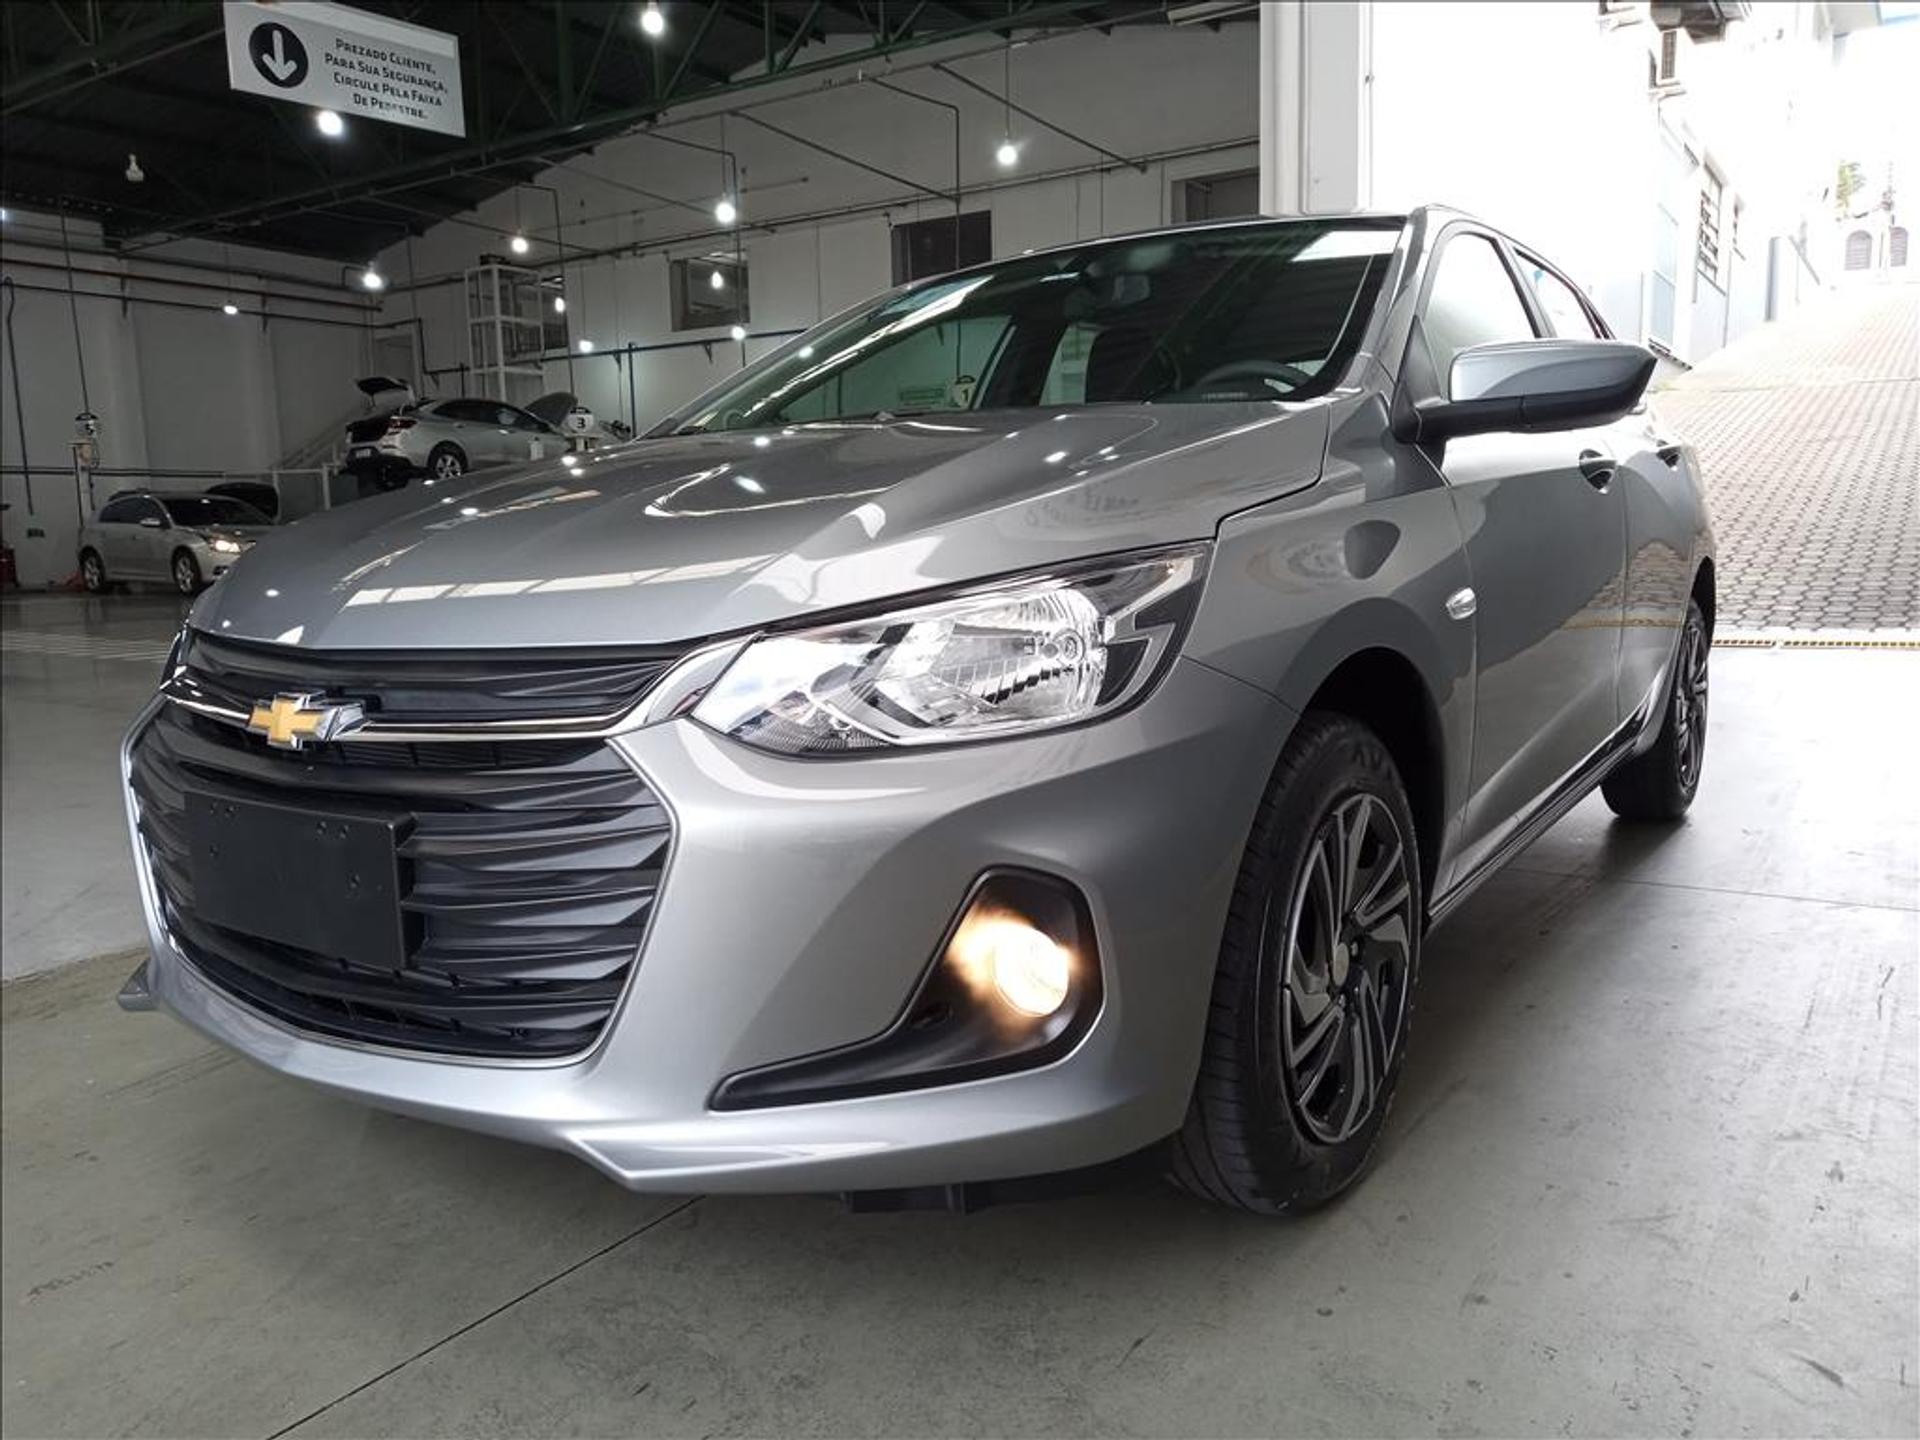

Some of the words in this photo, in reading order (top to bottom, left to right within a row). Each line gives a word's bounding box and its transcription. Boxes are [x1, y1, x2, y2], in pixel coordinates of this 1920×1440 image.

[336, 37, 388, 62] PREZADO
[324, 52, 356, 70] PARA
[358, 60, 380, 76] SUA
[334, 71, 380, 93] CIRCULE
[382, 82, 410, 100] PELA
[411, 89, 442, 106] FAIXA
[353, 93, 368, 106] DE
[576, 416, 586, 429] 3
